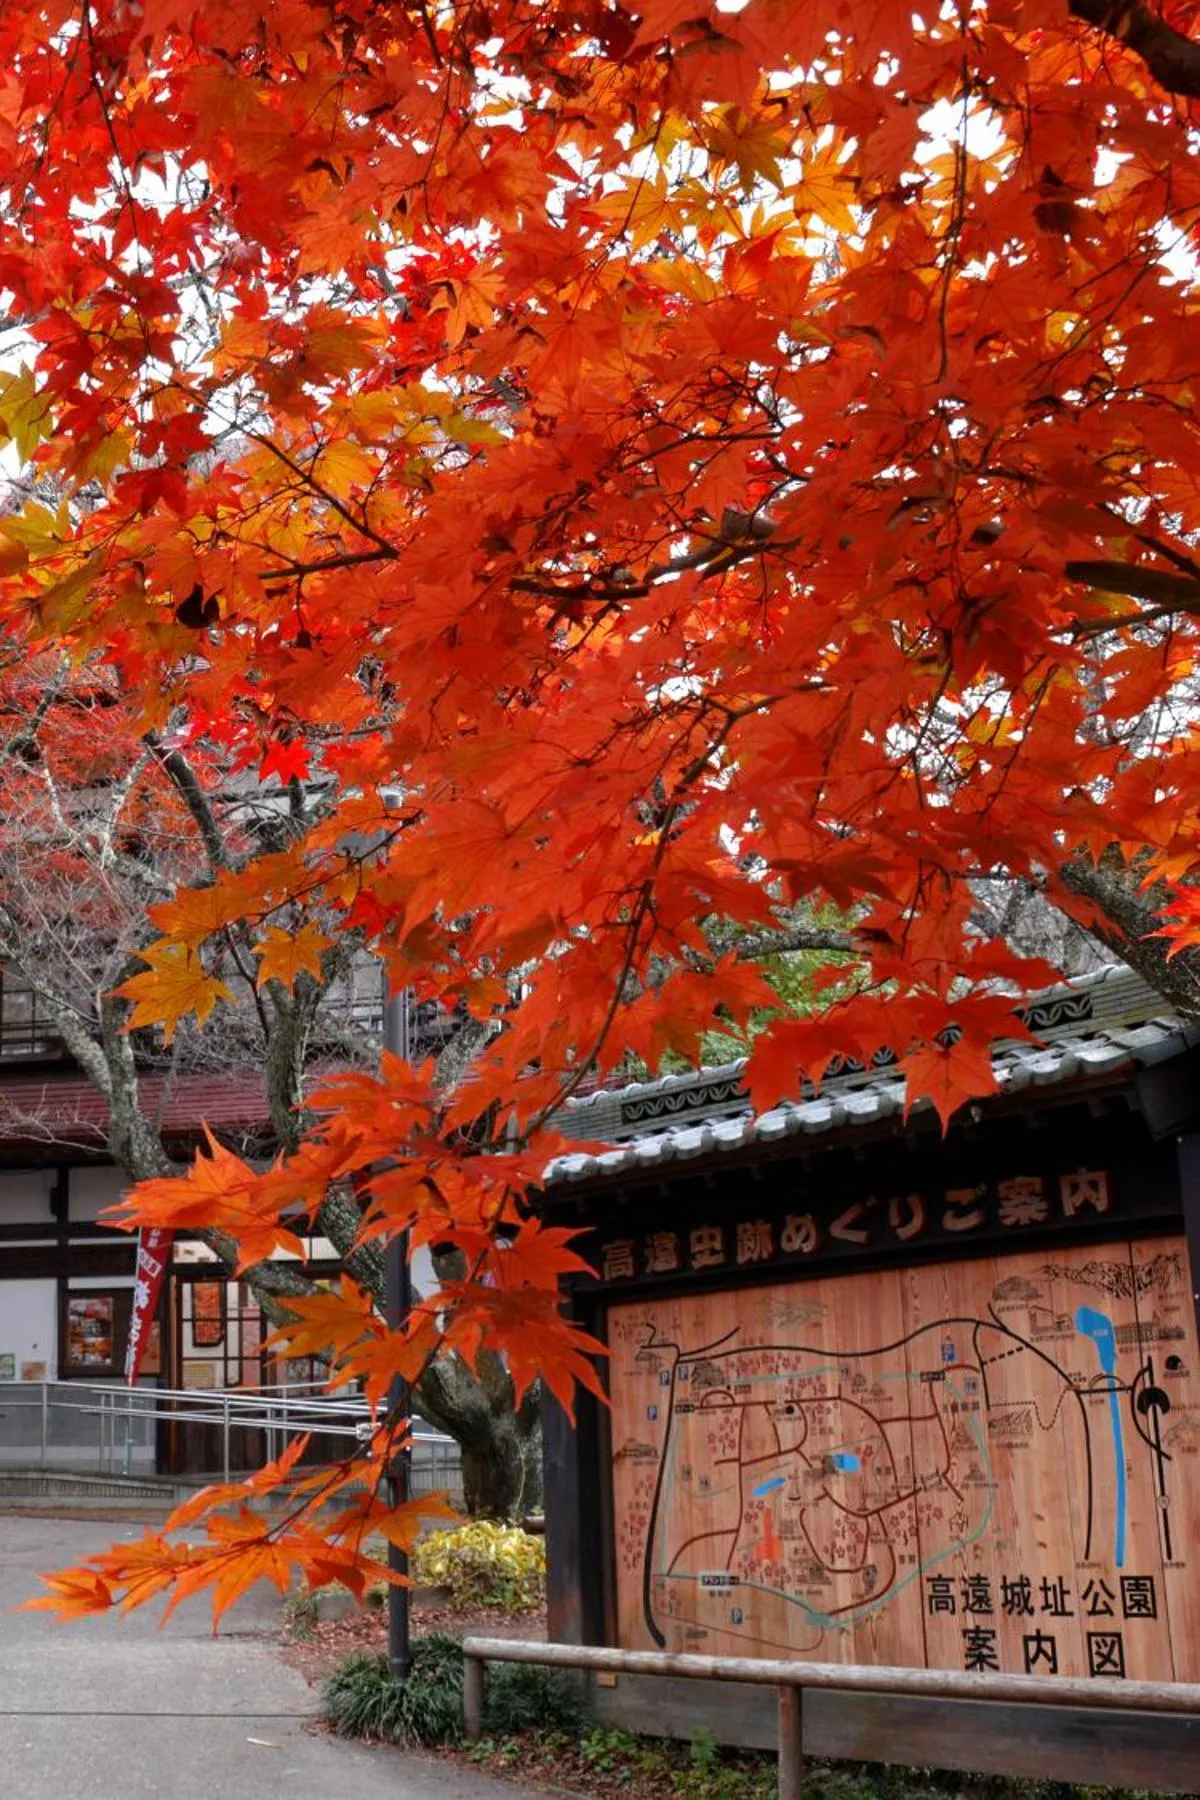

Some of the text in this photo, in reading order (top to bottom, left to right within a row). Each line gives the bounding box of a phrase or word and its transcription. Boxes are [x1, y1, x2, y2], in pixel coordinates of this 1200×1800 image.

[602, 1167, 1112, 1281] 高遠史跡めぐりご案内
[926, 1574, 1157, 1619] 高遠城址公園
[962, 1625, 1125, 1679] 案内図
